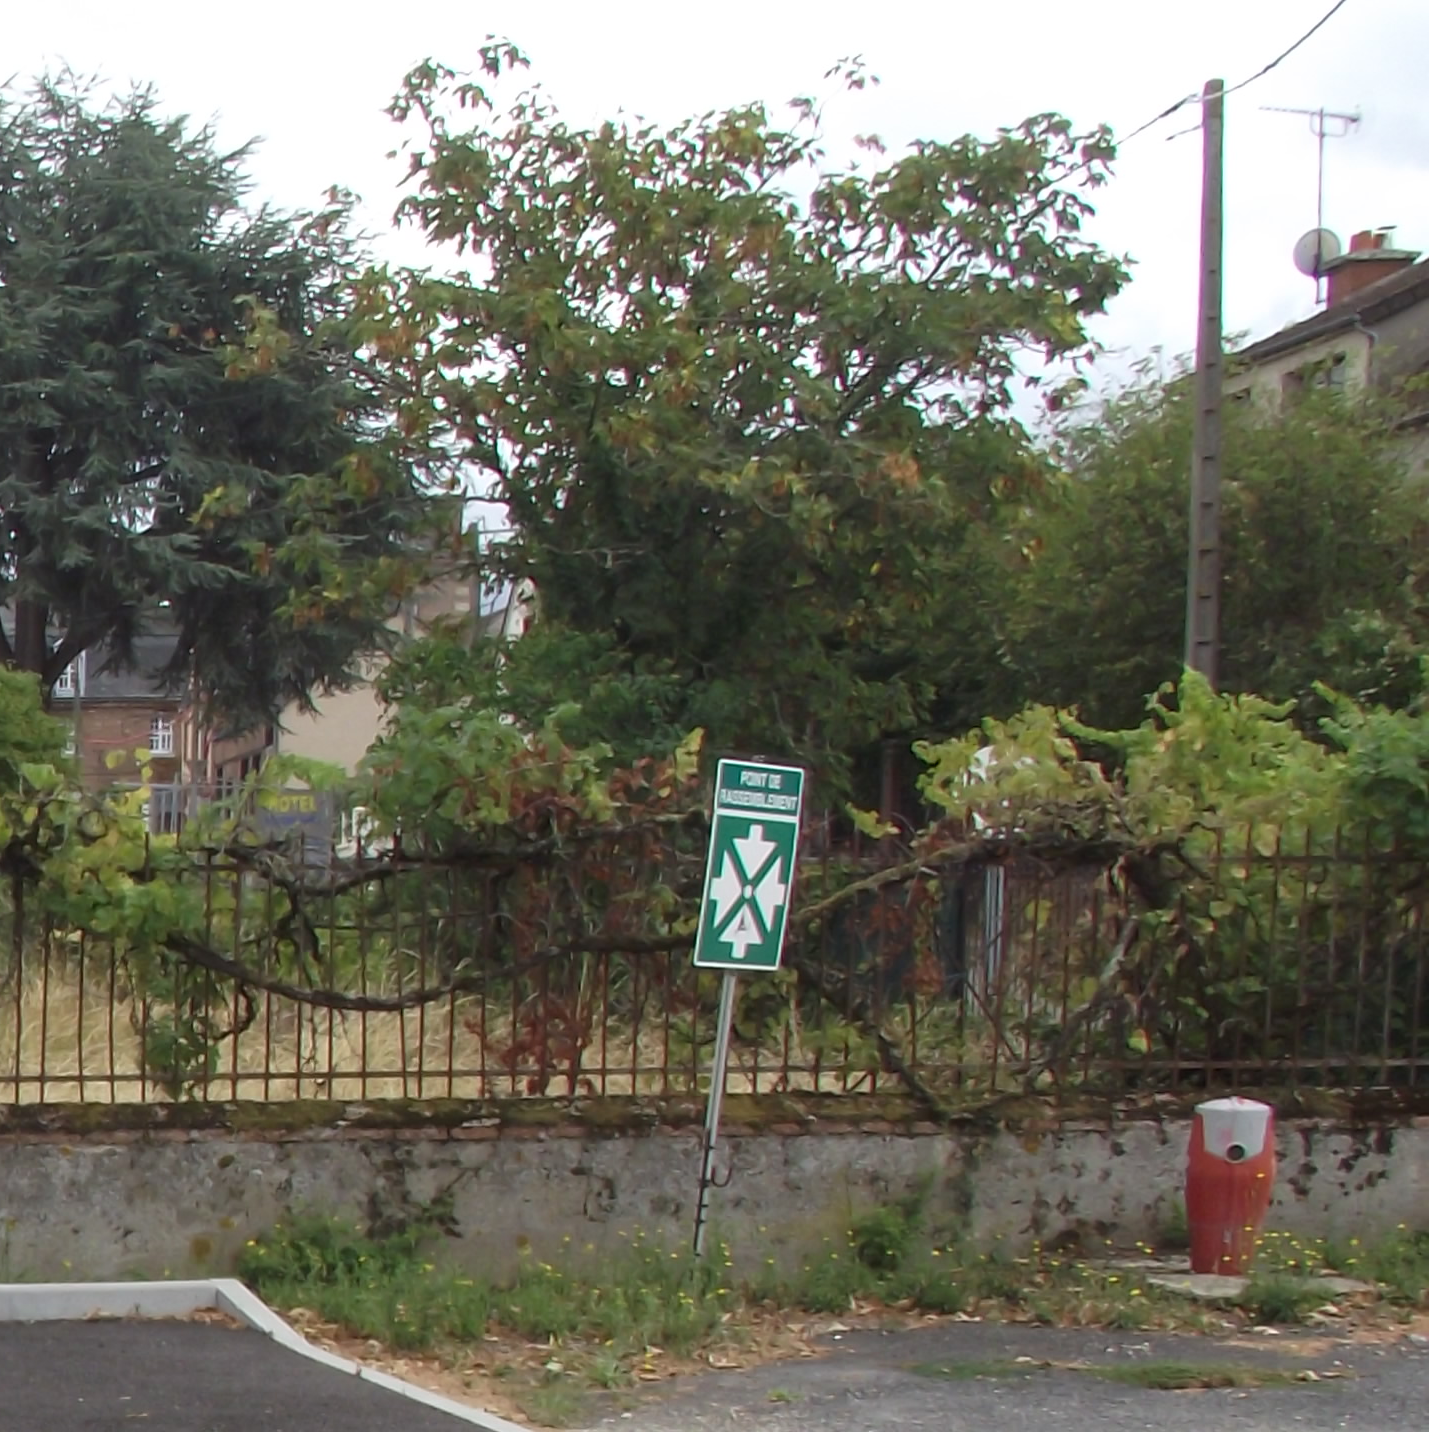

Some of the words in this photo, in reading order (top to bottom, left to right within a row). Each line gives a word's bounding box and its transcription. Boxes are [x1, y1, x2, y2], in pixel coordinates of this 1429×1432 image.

[740, 771, 768, 787] POINT
[768, 774, 782, 790] DE
[719, 789, 798, 811] RASSEMBLEMENT
